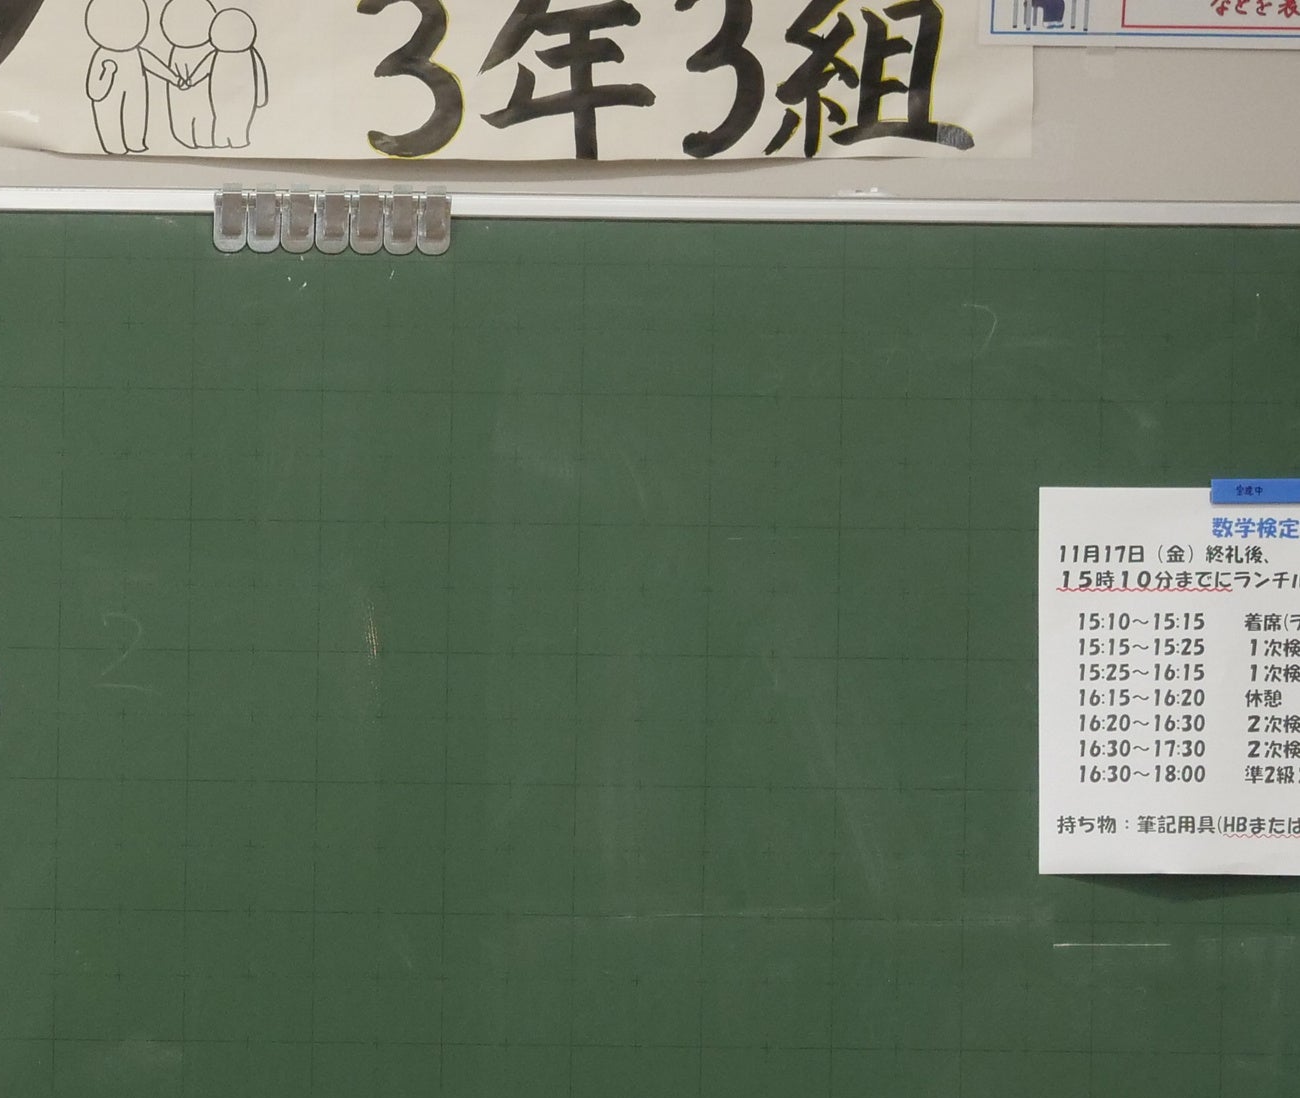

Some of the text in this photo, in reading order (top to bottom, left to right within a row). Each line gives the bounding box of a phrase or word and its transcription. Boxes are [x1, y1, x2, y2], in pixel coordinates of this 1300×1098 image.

[1211, 517, 1299, 538] 数学検定
[1244, 689, 1282, 708] 休憩
[1244, 765, 1300, 784] 準2級
